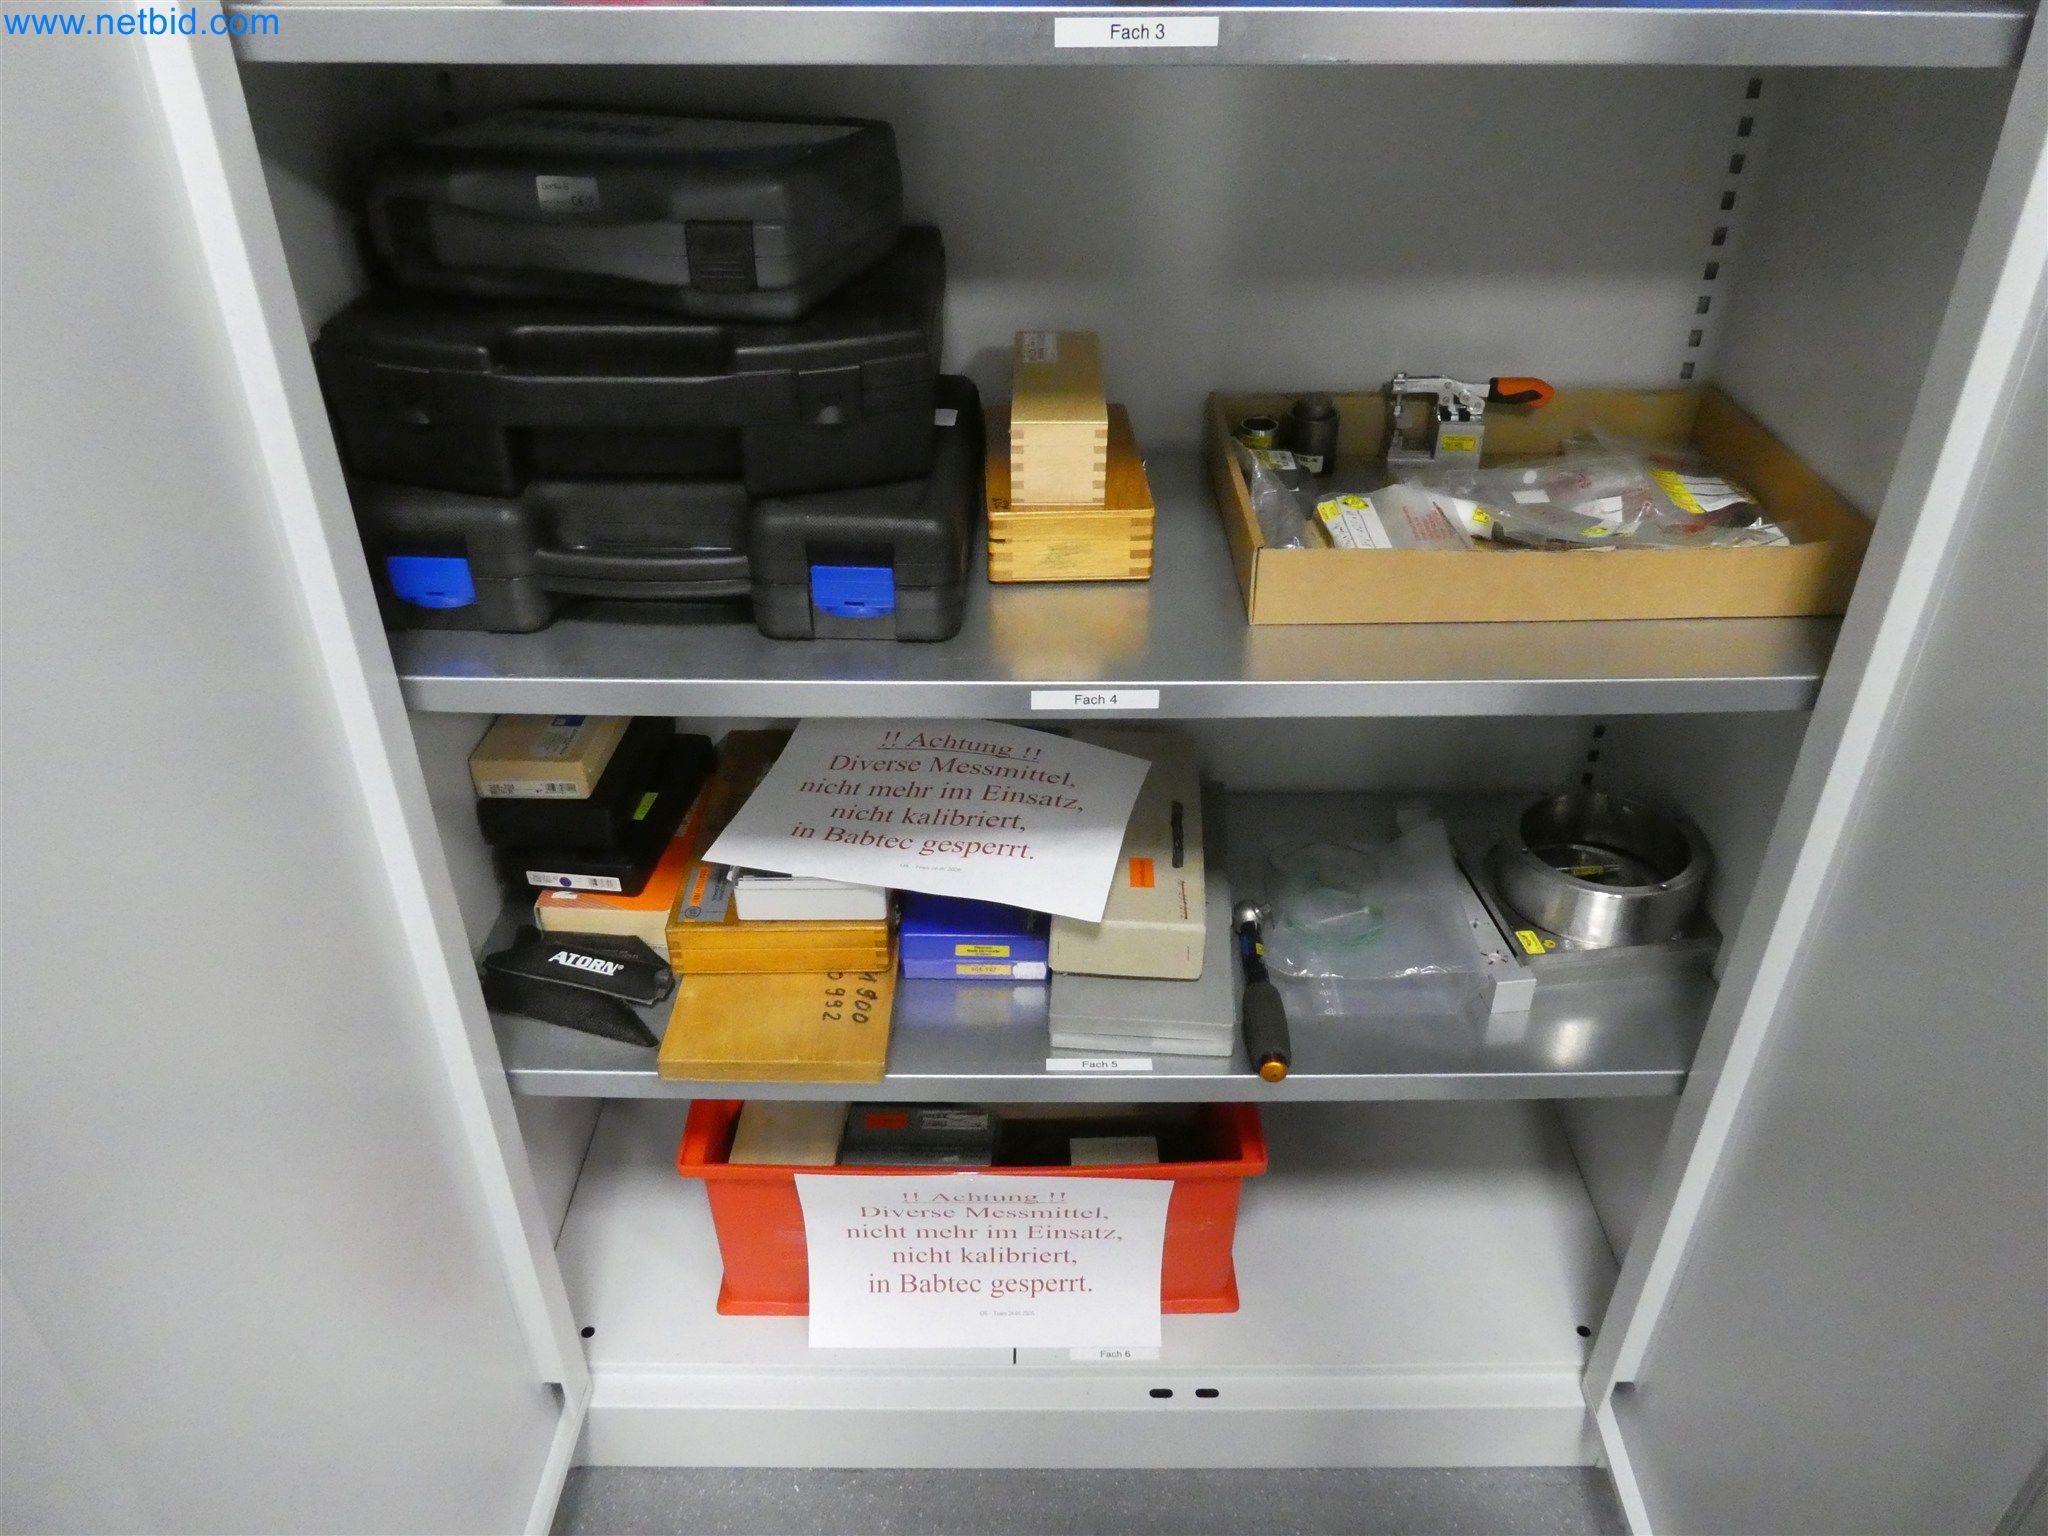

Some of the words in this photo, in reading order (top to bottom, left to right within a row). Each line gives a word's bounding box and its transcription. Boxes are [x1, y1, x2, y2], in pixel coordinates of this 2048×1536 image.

[1110, 23, 1149, 40] Fach
[1155, 23, 1165, 40] 3
[1074, 694, 1105, 705] Fach
[1109, 694, 1118, 704] 4
[907, 732, 1013, 759] Achtung
[828, 754, 922, 772] Diverse
[929, 756, 1076, 788] Messmittel,
[800, 778, 862, 796] nicht
[866, 781, 934, 799] mehr
[940, 782, 972, 800] im
[981, 784, 1083, 812] Einsatz,
[829, 804, 895, 823] nicht
[901, 807, 1026, 832] kalibriert,
[790, 821, 816, 839] in
[824, 826, 914, 850] Babtec
[918, 839, 1034, 860] gesperrt.
[1082, 1060, 1108, 1068] Fach
[1111, 1060, 1118, 1068] 5
[931, 1192, 1039, 1204] Achtung
[861, 1206, 956, 1218] Diverse
[966, 1206, 1109, 1220] Messmittel,
[847, 1224, 908, 1239] nicht
[916, 1225, 978, 1239] mehr
[988, 1225, 1017, 1239] im
[1028, 1225, 1123, 1241] Einsatz,
[892, 1247, 952, 1263] nicht
[961, 1247, 1078, 1265] kalibriert,
[869, 1273, 890, 1293] in
[900, 1273, 982, 1293] Babtec
[990, 1275, 1093, 1299] gesperrt.
[1100, 1350, 1122, 1358] Fach
[1124, 1350, 1131, 1358] 6
